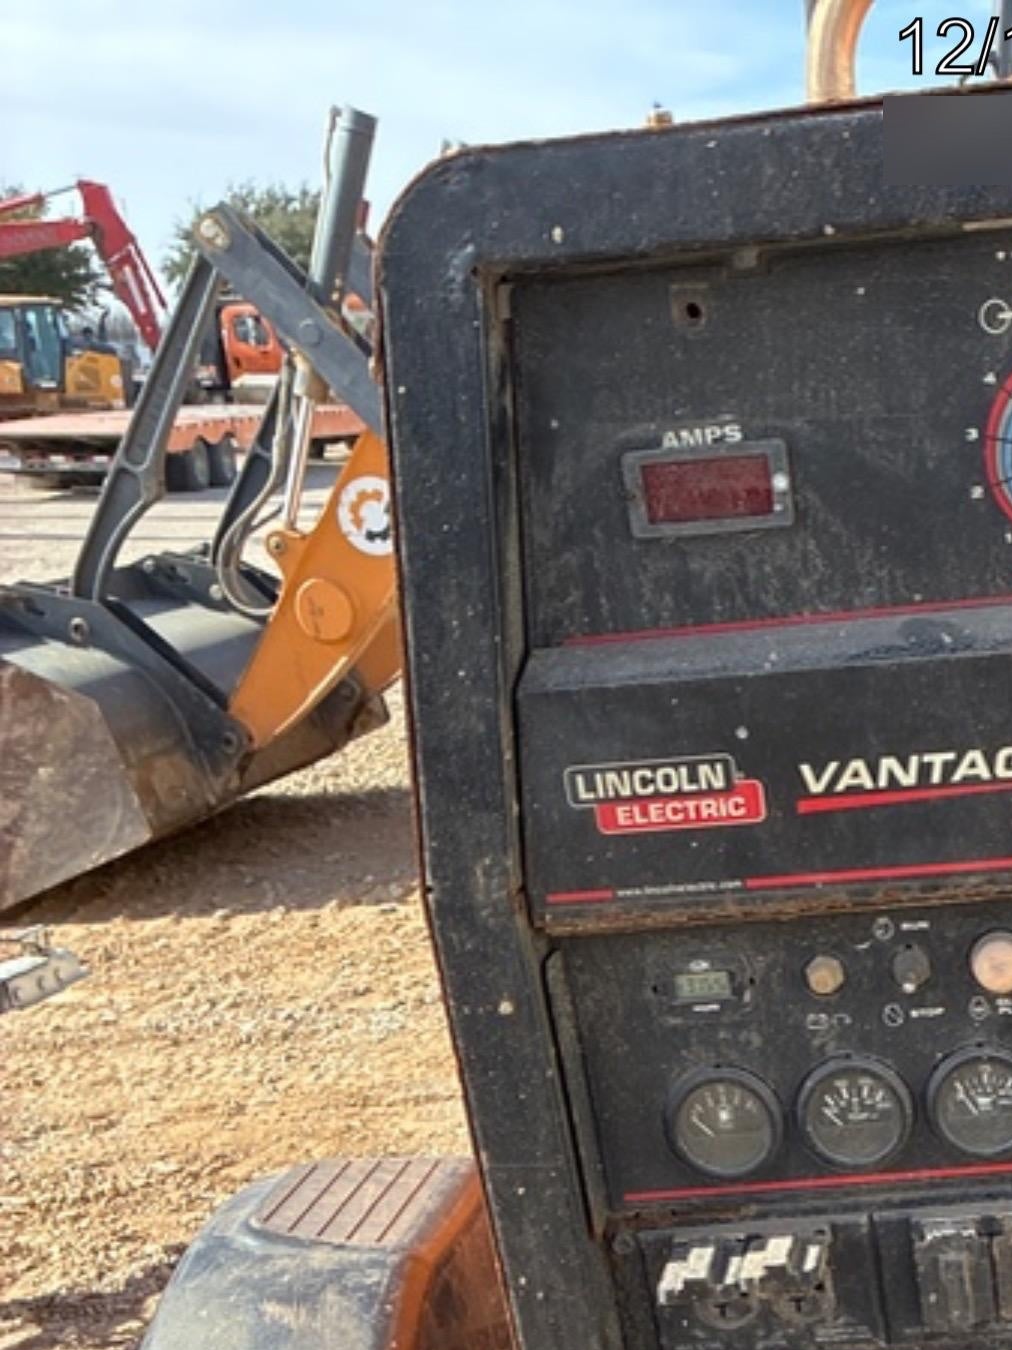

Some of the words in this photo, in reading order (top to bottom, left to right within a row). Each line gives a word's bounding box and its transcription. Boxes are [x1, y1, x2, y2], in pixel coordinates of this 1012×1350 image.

[662, 424, 744, 449] AMPS
[574, 761, 726, 802] LINCOLN
[616, 795, 747, 828] ELECTRIC
